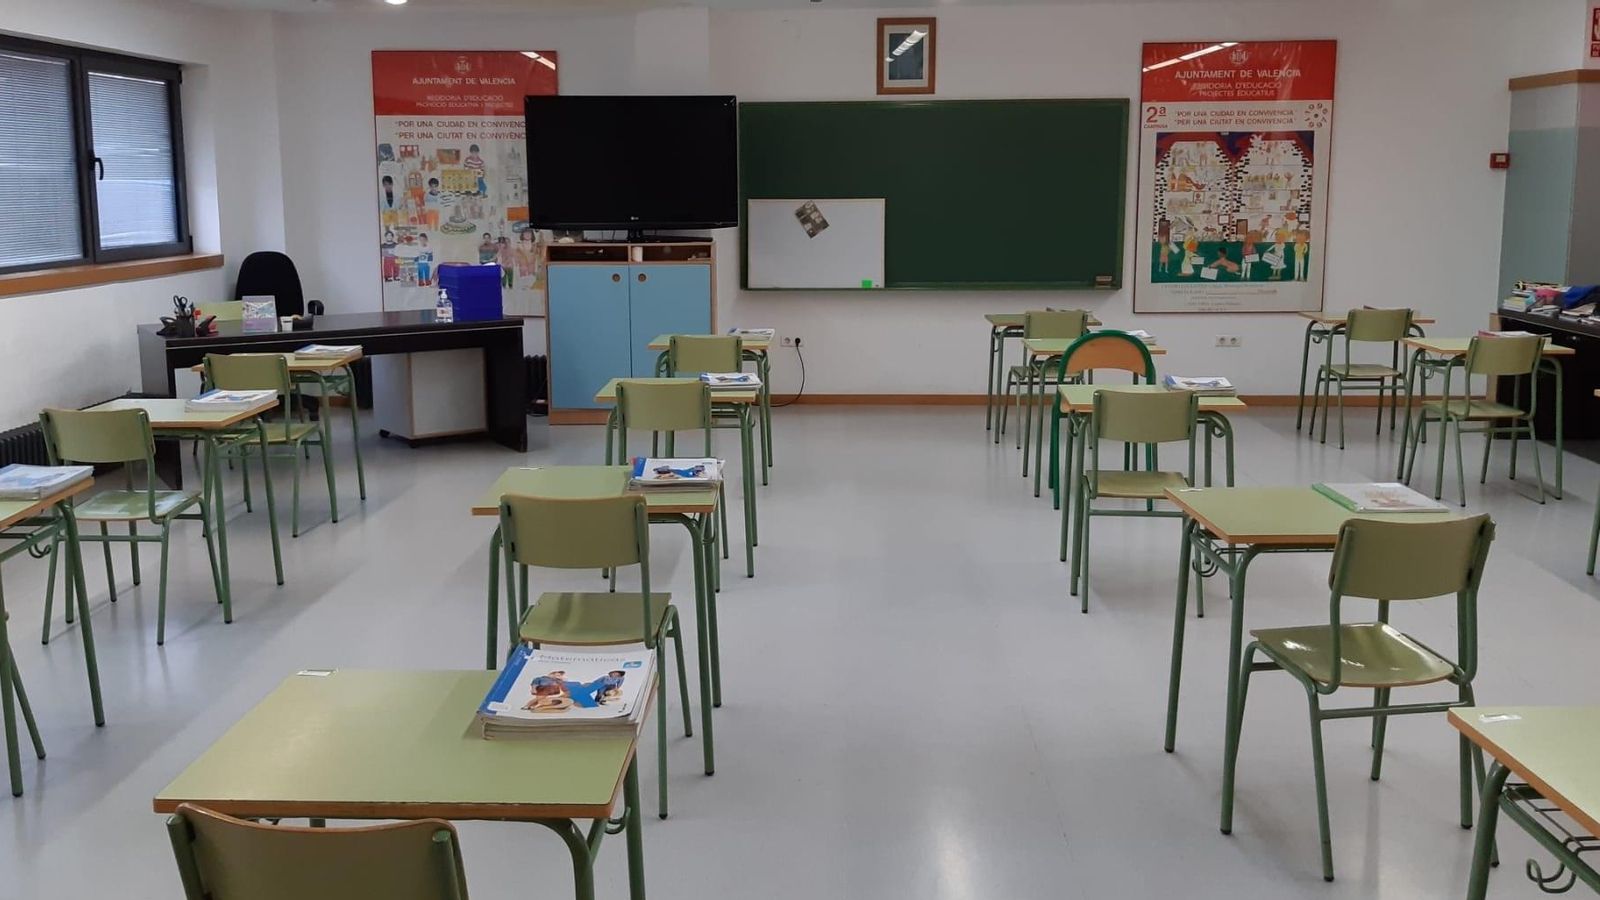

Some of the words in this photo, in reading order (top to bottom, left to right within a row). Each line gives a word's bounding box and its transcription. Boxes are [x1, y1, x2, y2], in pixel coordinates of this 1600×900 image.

[1174, 70, 1236, 79] AJUNTAMENT
[1240, 69, 1253, 78] DE
[1257, 68, 1302, 78] VALENCIA
[412, 77, 462, 85] AJUNTAMENT
[465, 77, 476, 85] DE
[479, 77, 516, 85] VALENCIA
[1146, 106, 1167, 123] 2ª
[416, 120, 433, 128] UNA
[436, 120, 465, 128] CIUDAD
[467, 120, 478, 128] EN
[481, 120, 526, 128] CONVIVENC
[417, 131, 434, 140] UNA
[437, 131, 463, 140] CIUTAT
[466, 131, 477, 140] EN
